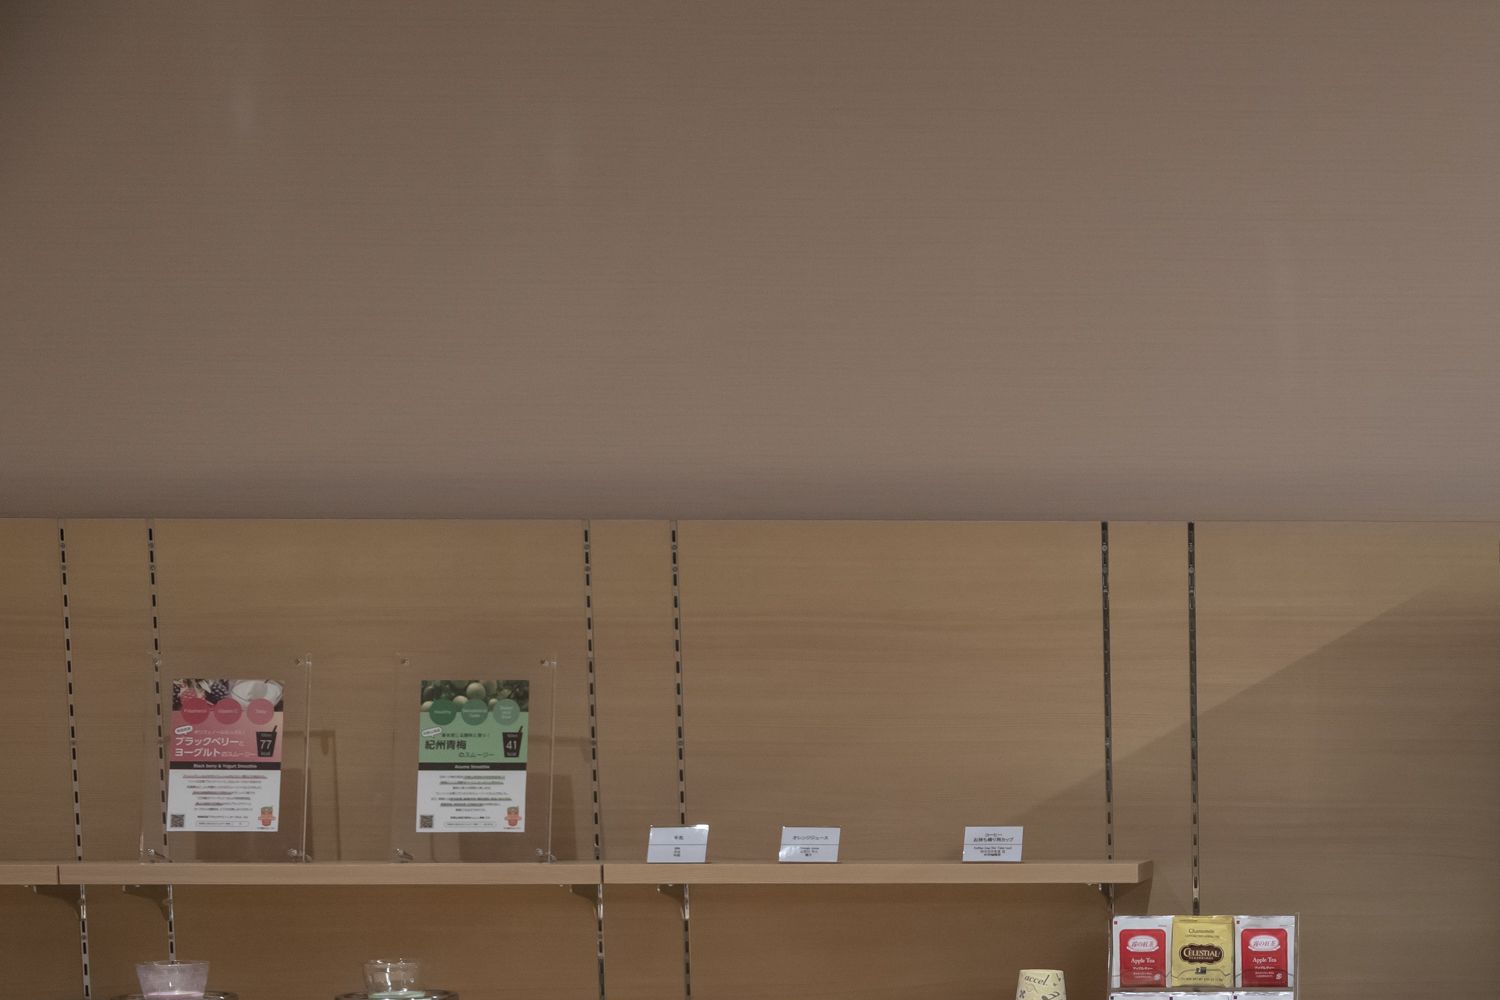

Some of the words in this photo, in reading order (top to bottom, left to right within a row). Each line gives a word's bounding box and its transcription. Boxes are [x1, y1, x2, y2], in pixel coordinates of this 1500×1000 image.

[259, 740, 272, 749] 77
[424, 739, 468, 751] 紀州青梅
[505, 740, 518, 749] 41
